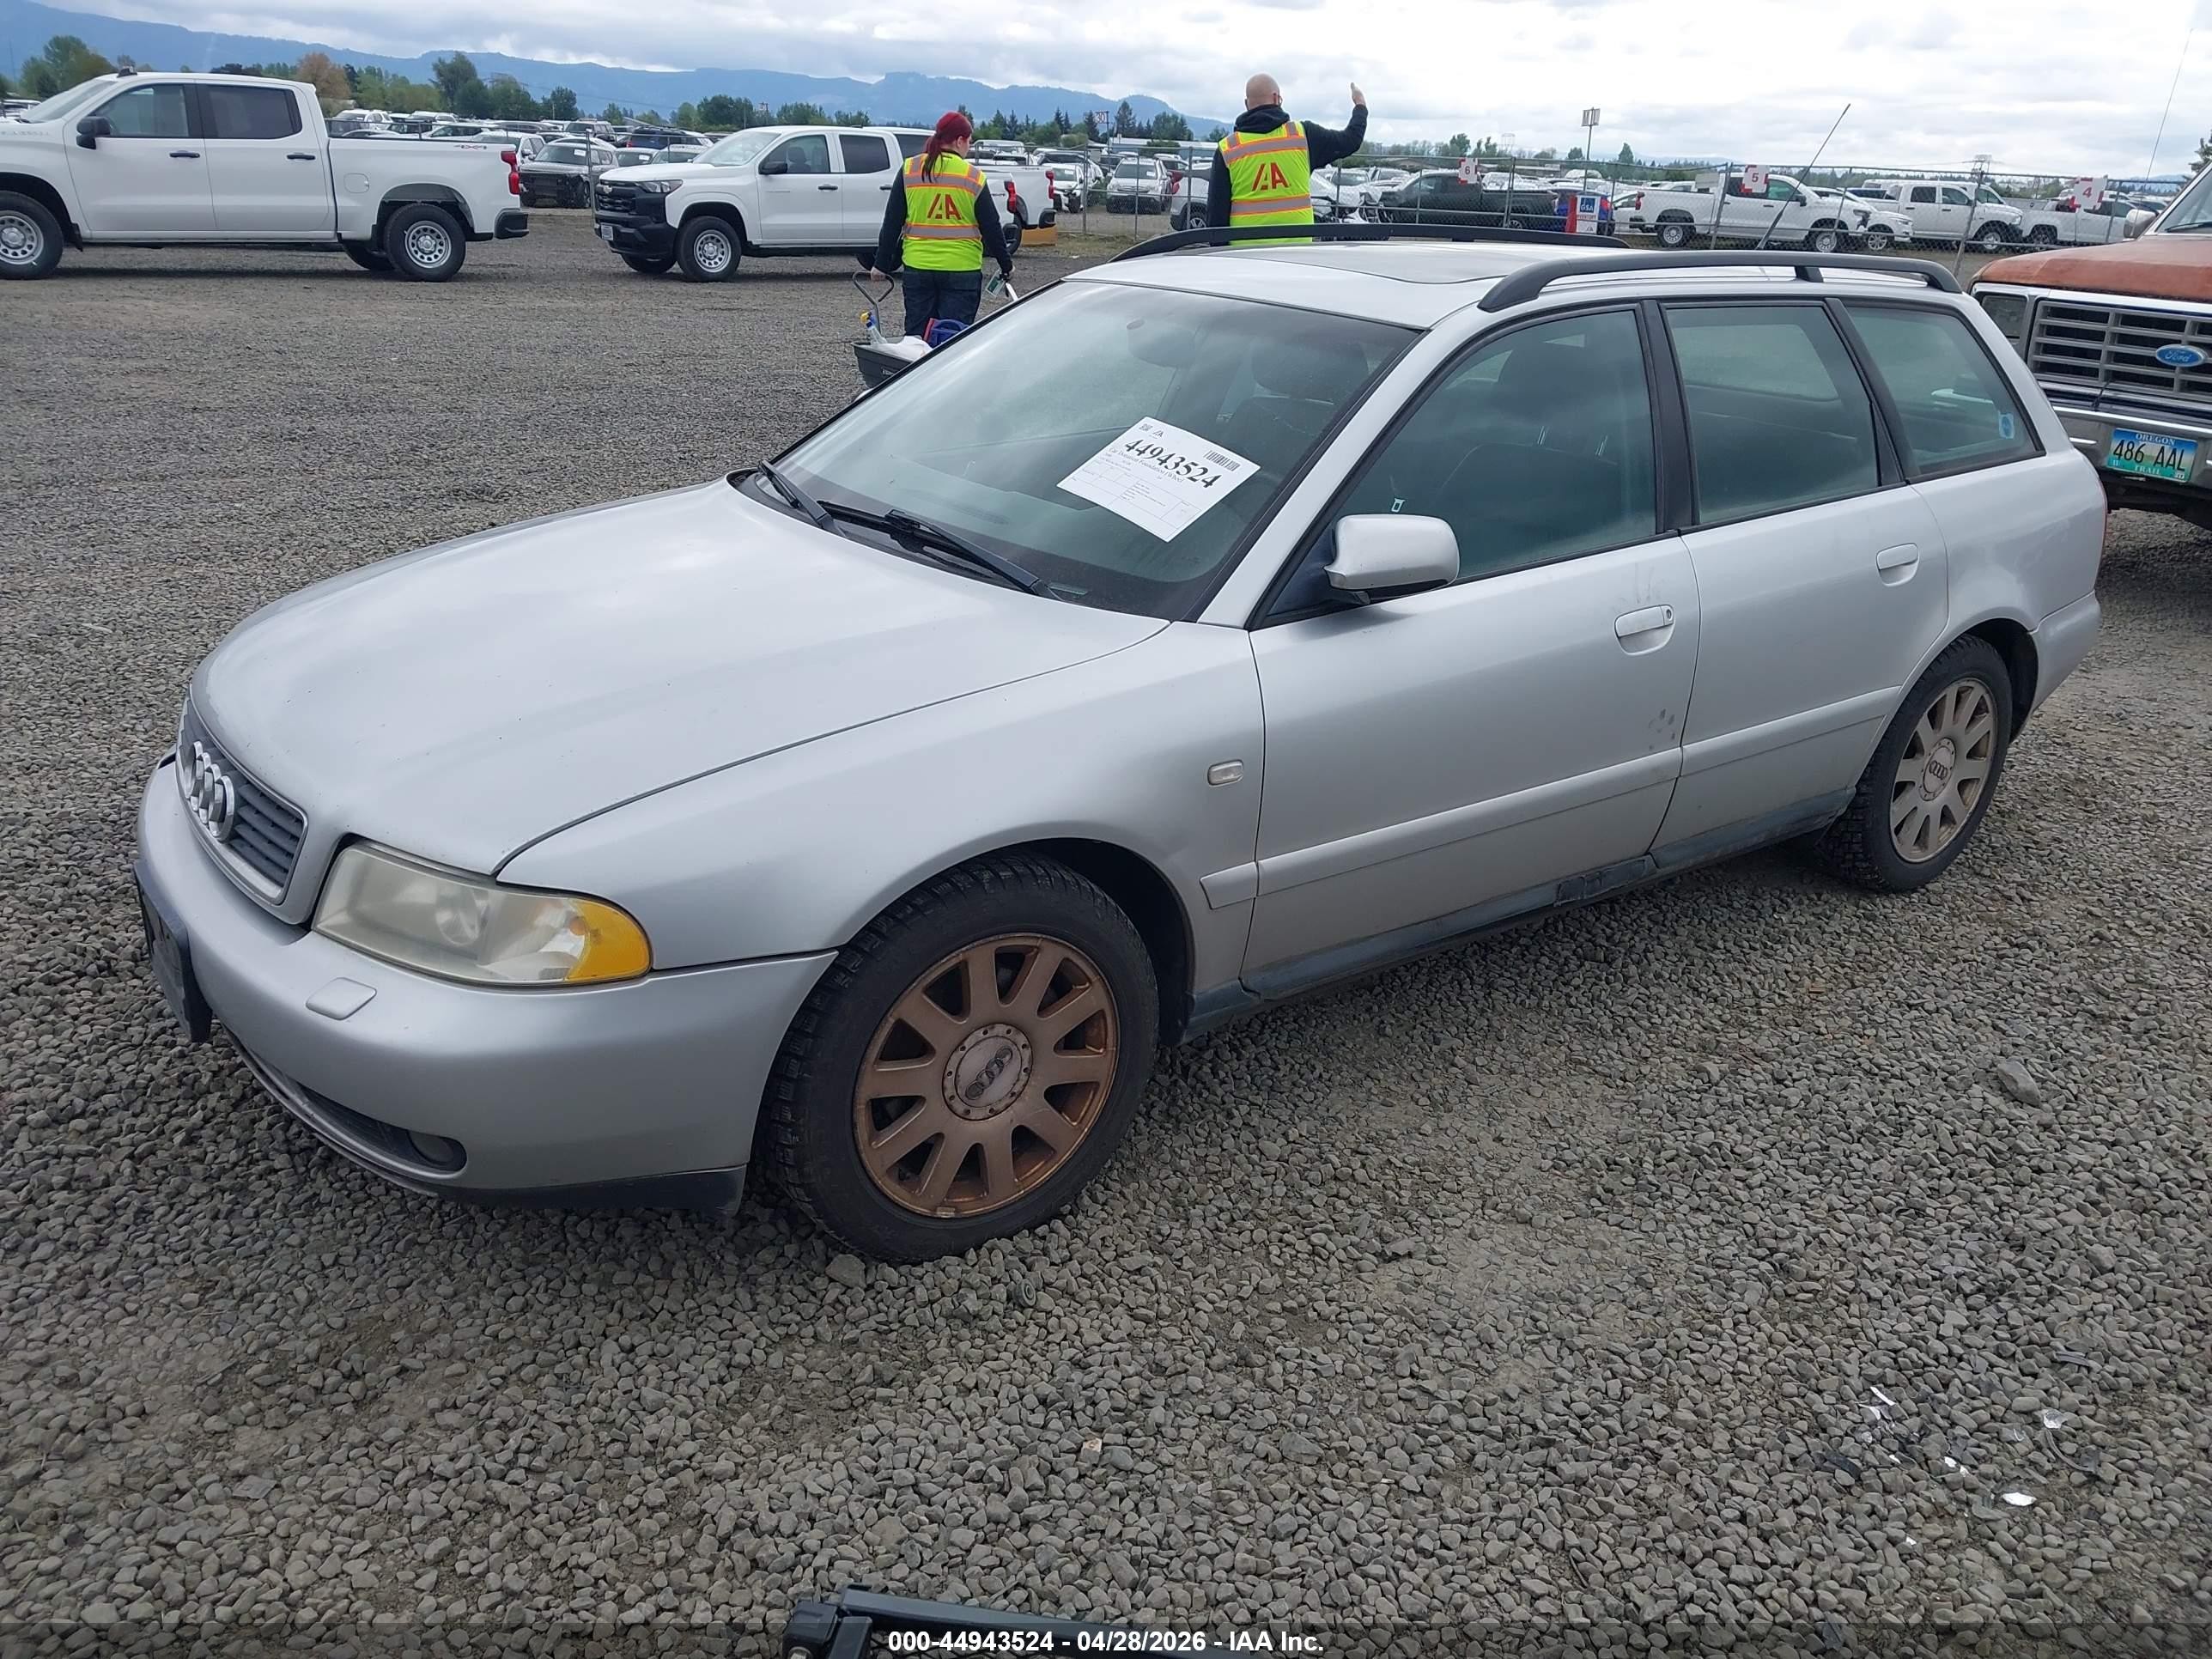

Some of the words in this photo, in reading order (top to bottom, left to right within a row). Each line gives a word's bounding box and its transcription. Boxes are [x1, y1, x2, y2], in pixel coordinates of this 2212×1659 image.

[1464, 165, 1471, 175] 6
[1752, 173, 1759, 183] 5
[2082, 186, 2092, 198] 4
[2165, 350, 2192, 362] Ford
[2136, 433, 2176, 446] OREGON
[2112, 439, 2147, 464] 486
[2153, 445, 2185, 471] AAL
[1124, 439, 1222, 489] 44943524
